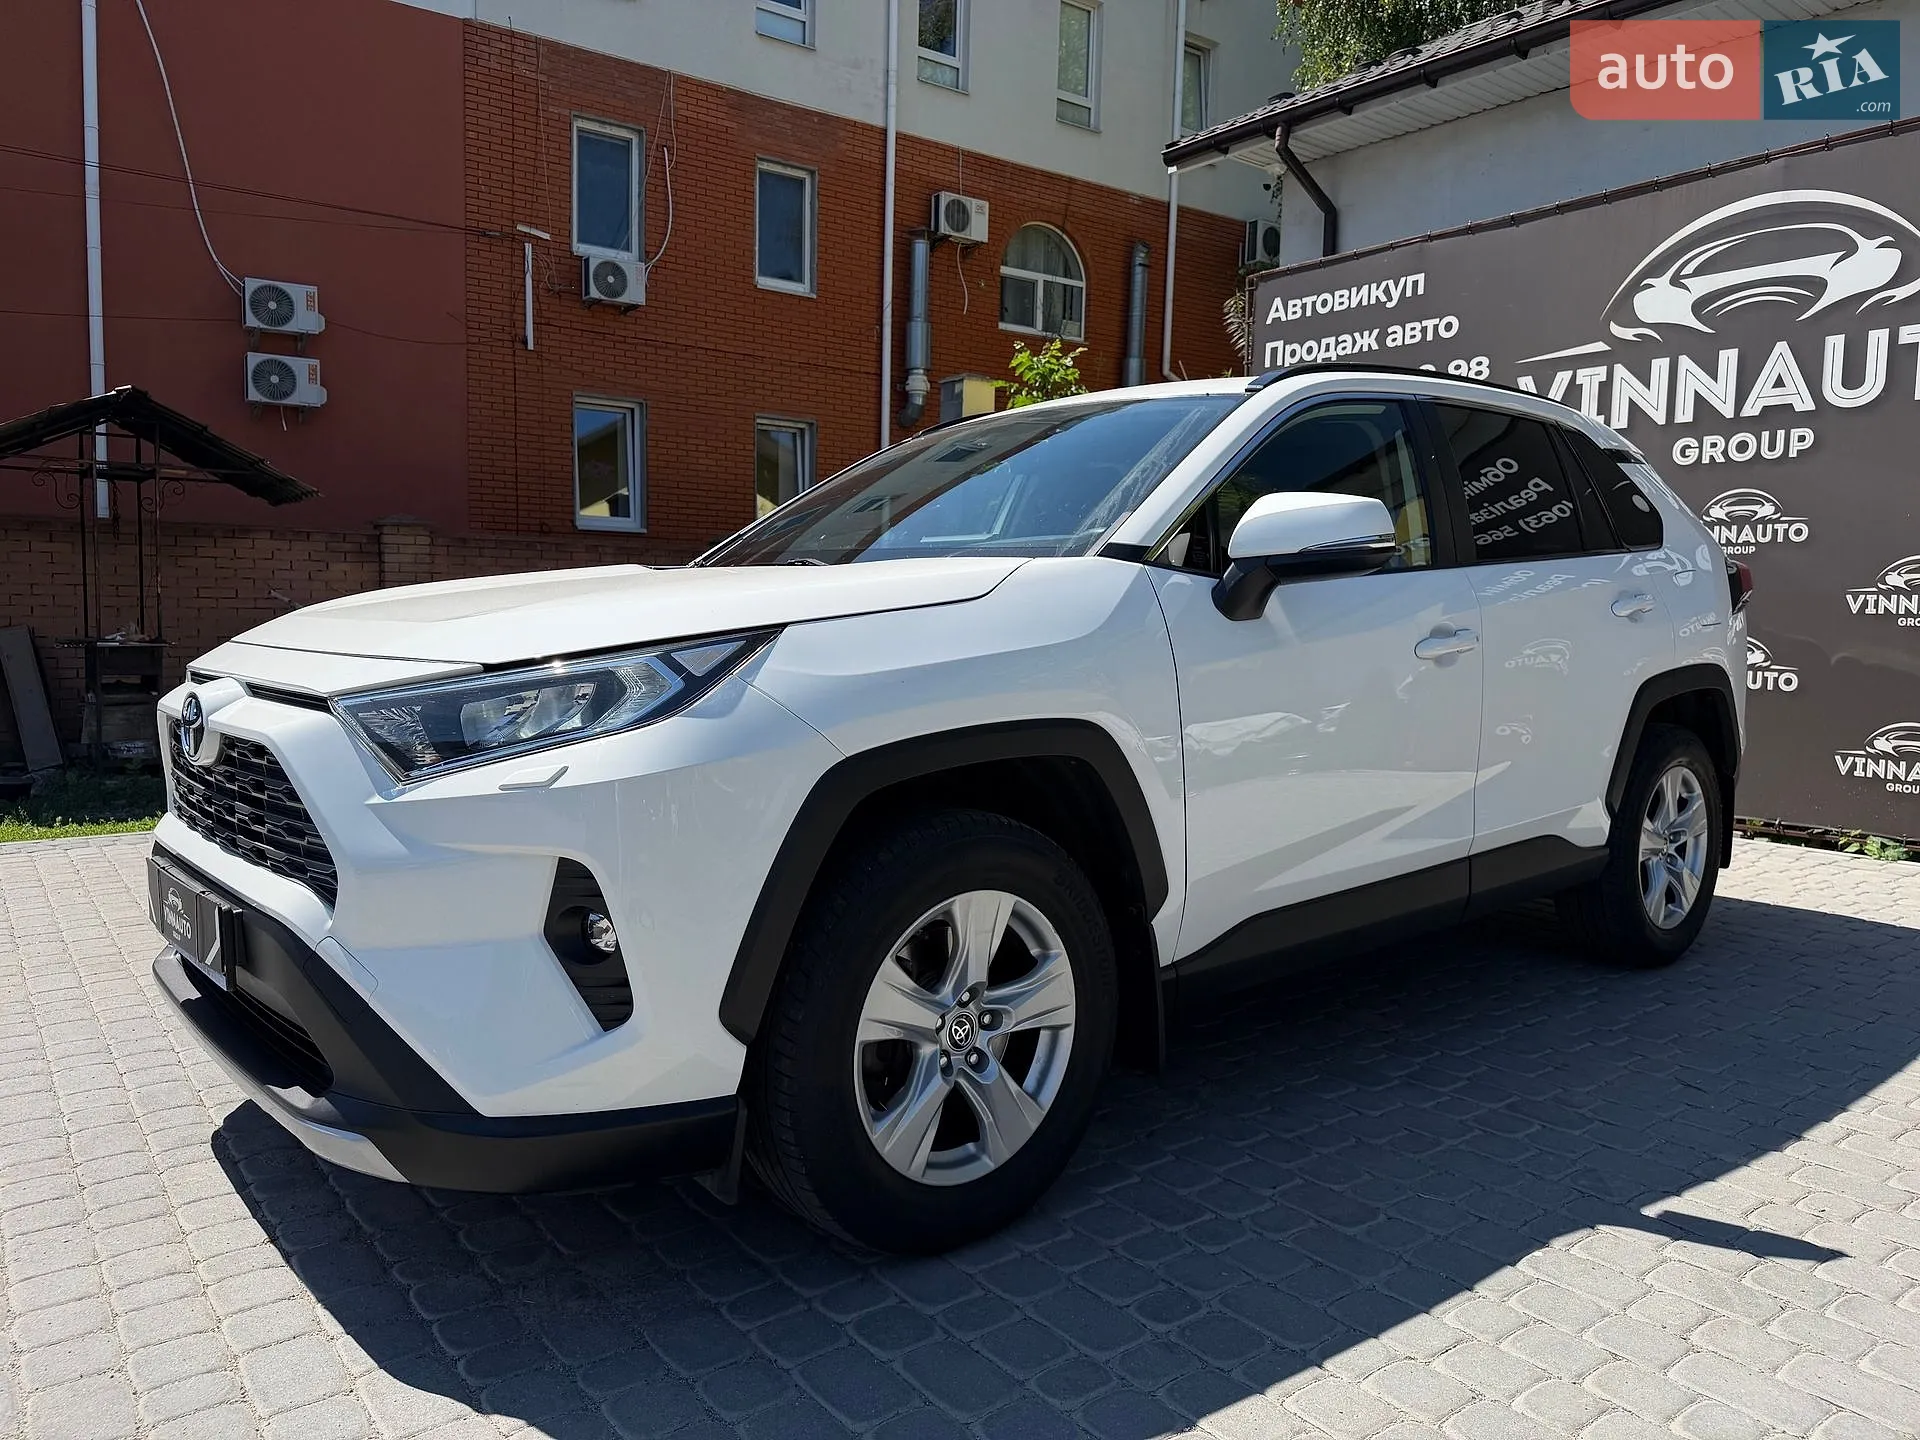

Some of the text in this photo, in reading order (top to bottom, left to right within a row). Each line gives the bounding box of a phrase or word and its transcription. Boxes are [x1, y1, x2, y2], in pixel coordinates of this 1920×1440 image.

[1265, 272, 1426, 325] Автовикуп
[1264, 315, 1460, 369] Продаж авто
[1672, 427, 1815, 466] GROUP
[1845, 594, 1920, 615] VINN
